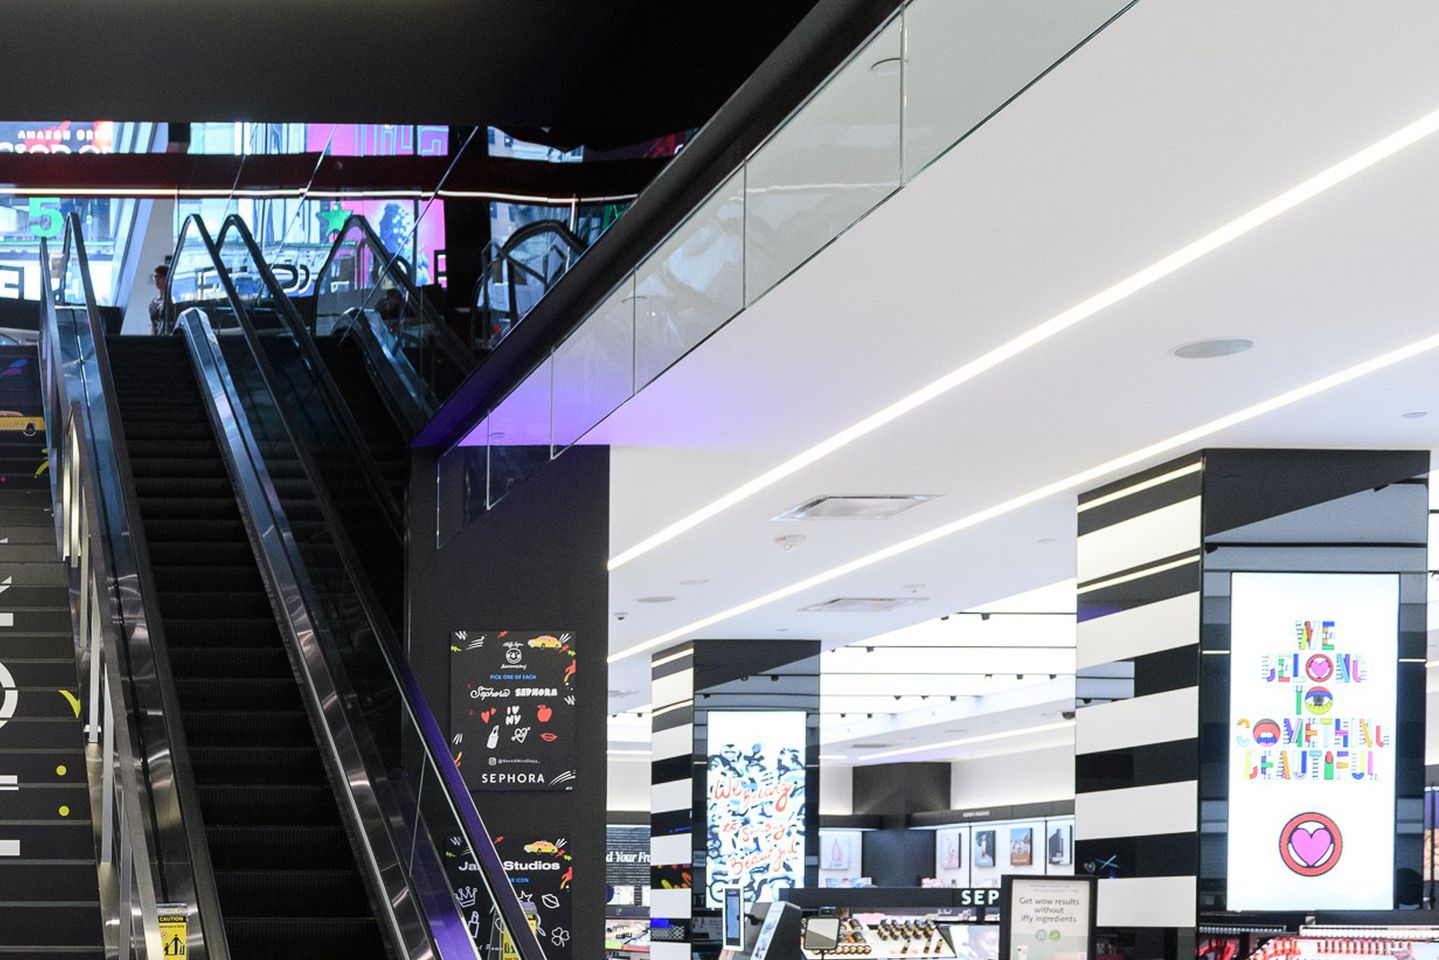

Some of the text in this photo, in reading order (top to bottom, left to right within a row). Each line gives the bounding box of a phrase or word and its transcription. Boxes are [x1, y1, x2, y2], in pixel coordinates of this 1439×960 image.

[17, 129, 72, 141] AMAZON
[1295, 620, 1335, 650] WE
[1261, 653, 1367, 683] BELONG
[470, 686, 558, 700] Sephora SEPHORA
[1294, 685, 1334, 716] TO
[1236, 718, 1390, 748] SOMETHING
[1244, 750, 1379, 780] BEAUTIFUL
[481, 773, 545, 784] SEPHORA
[615, 852, 638, 862] Your
[503, 860, 560, 871] Studios
[961, 890, 1000, 905] SEP
[1019, 897, 1033, 905] Get
[1055, 898, 1080, 906] results
[1021, 915, 1077, 923] iffy ingredients
